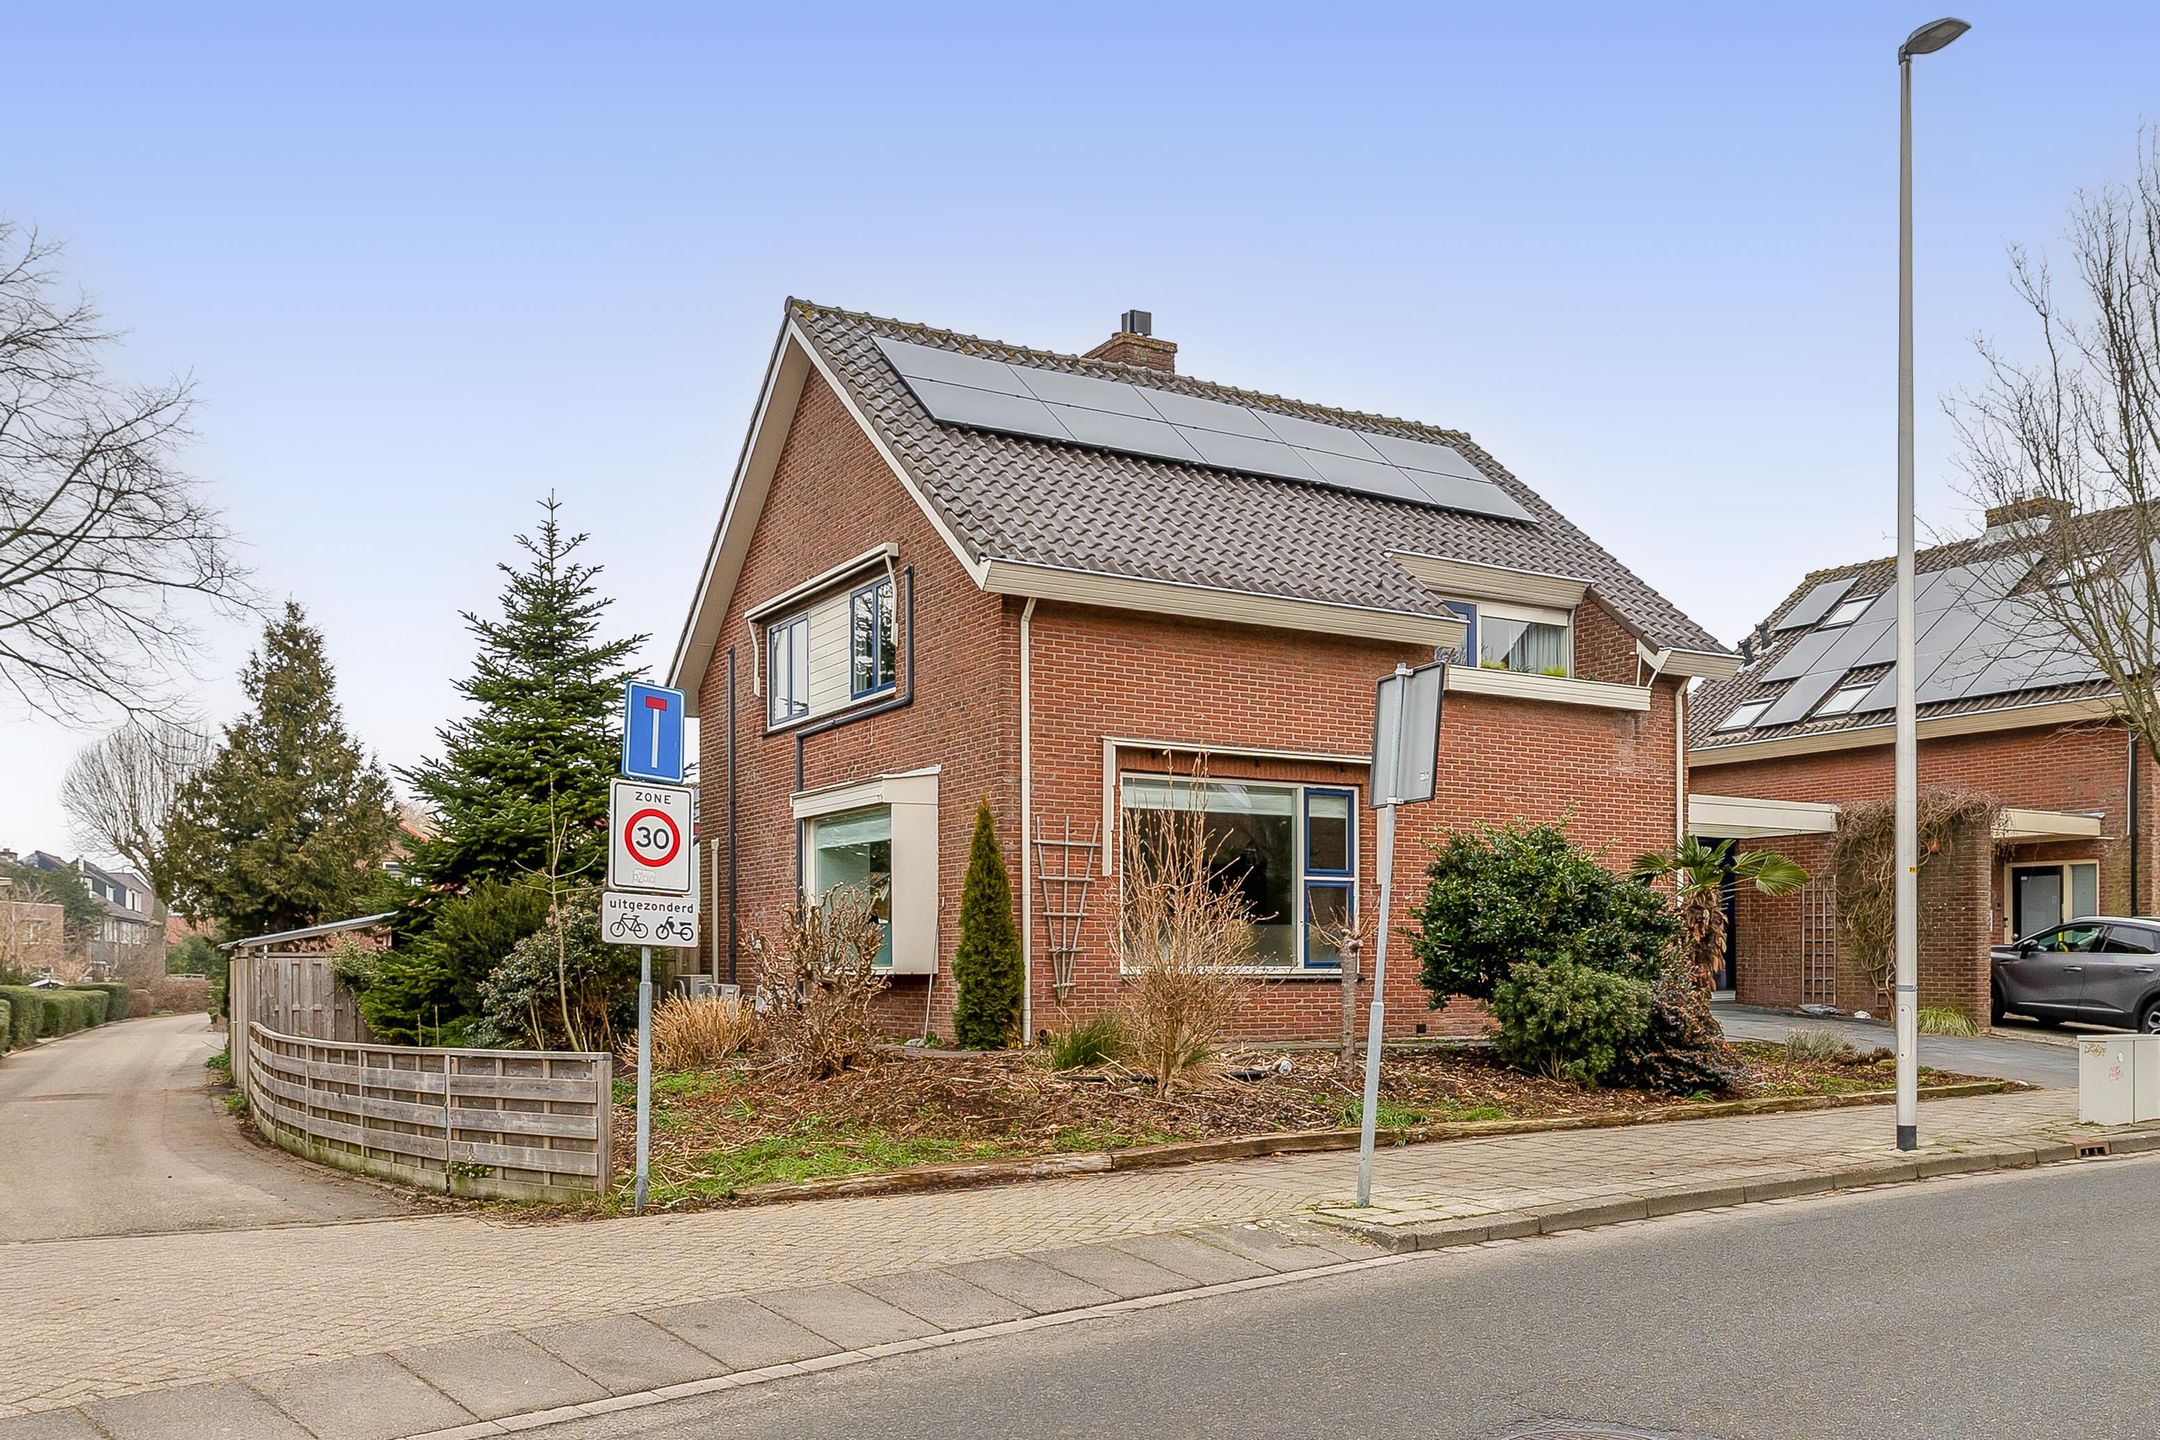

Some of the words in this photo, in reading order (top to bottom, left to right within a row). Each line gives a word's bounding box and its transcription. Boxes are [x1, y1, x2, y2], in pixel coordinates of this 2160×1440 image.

[635, 791, 671, 804] ZONE
[635, 826, 669, 849] 30
[609, 899, 694, 913] uitgezonderd
